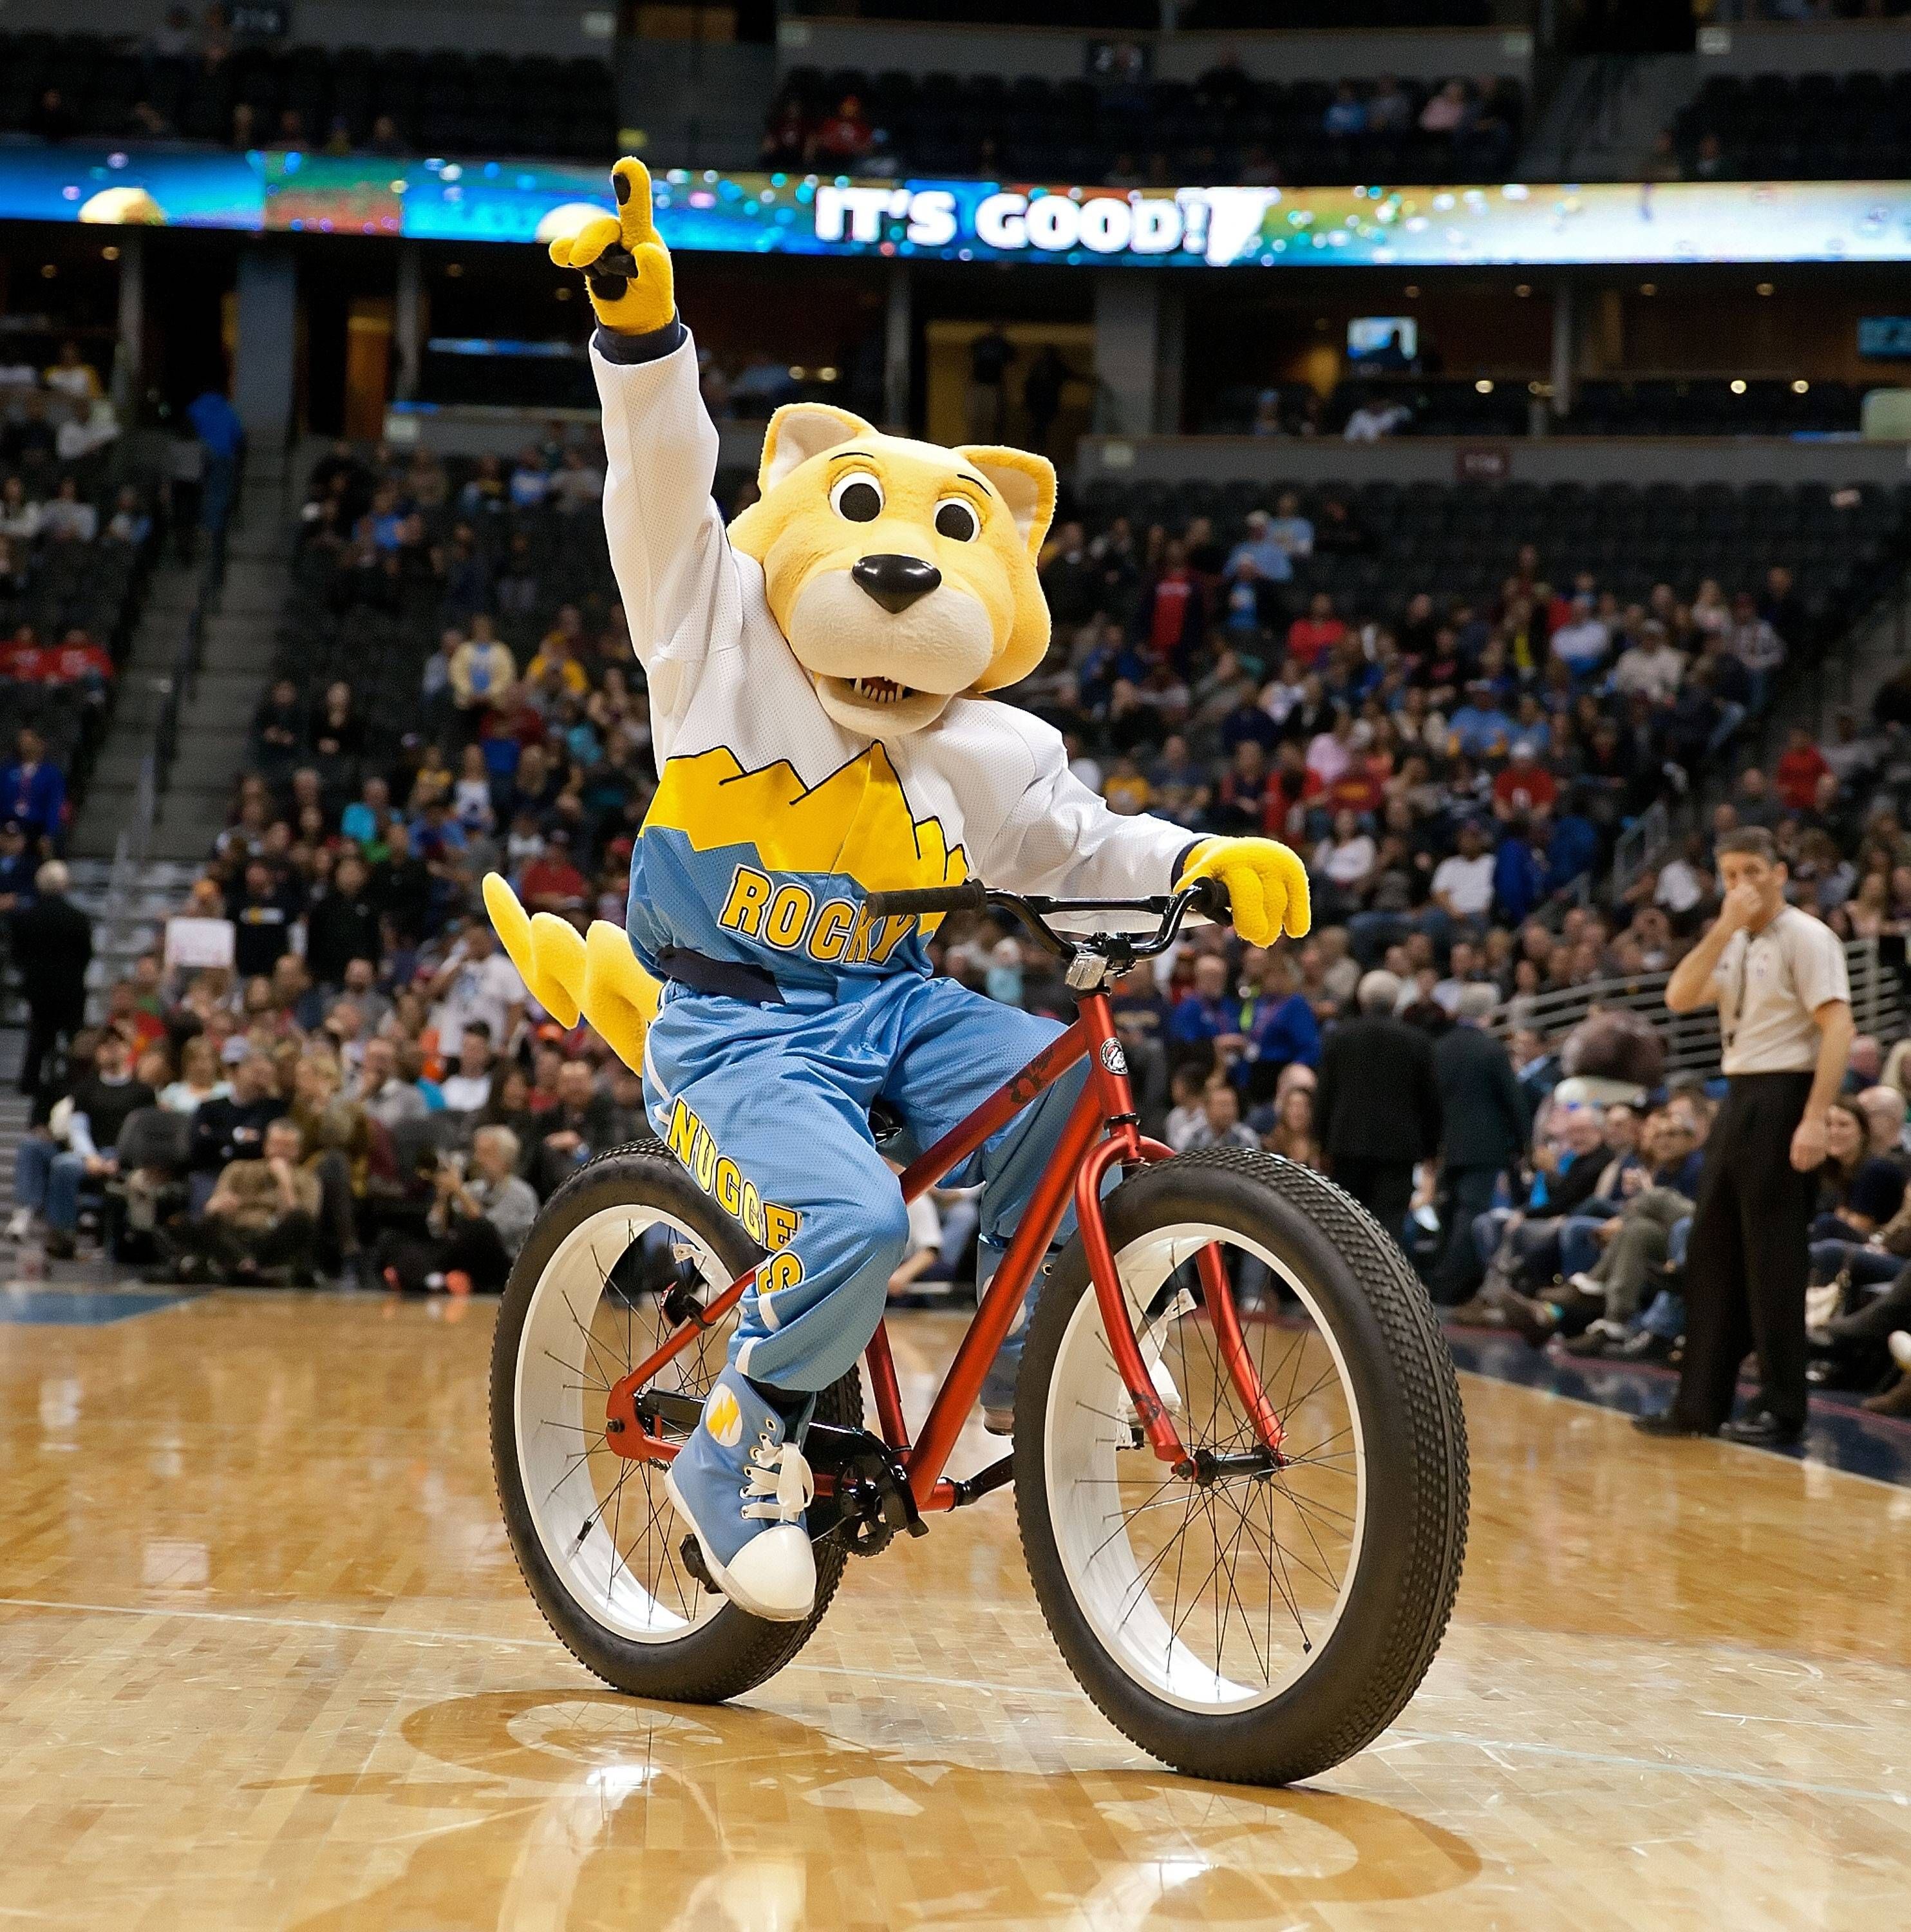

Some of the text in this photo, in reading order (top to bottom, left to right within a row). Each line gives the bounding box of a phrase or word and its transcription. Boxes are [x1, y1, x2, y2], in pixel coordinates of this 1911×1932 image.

[814, 185, 1209, 254] IT'S GOOD!
[717, 864, 918, 966] ROCKY
[666, 1094, 805, 1296] NUGGES
